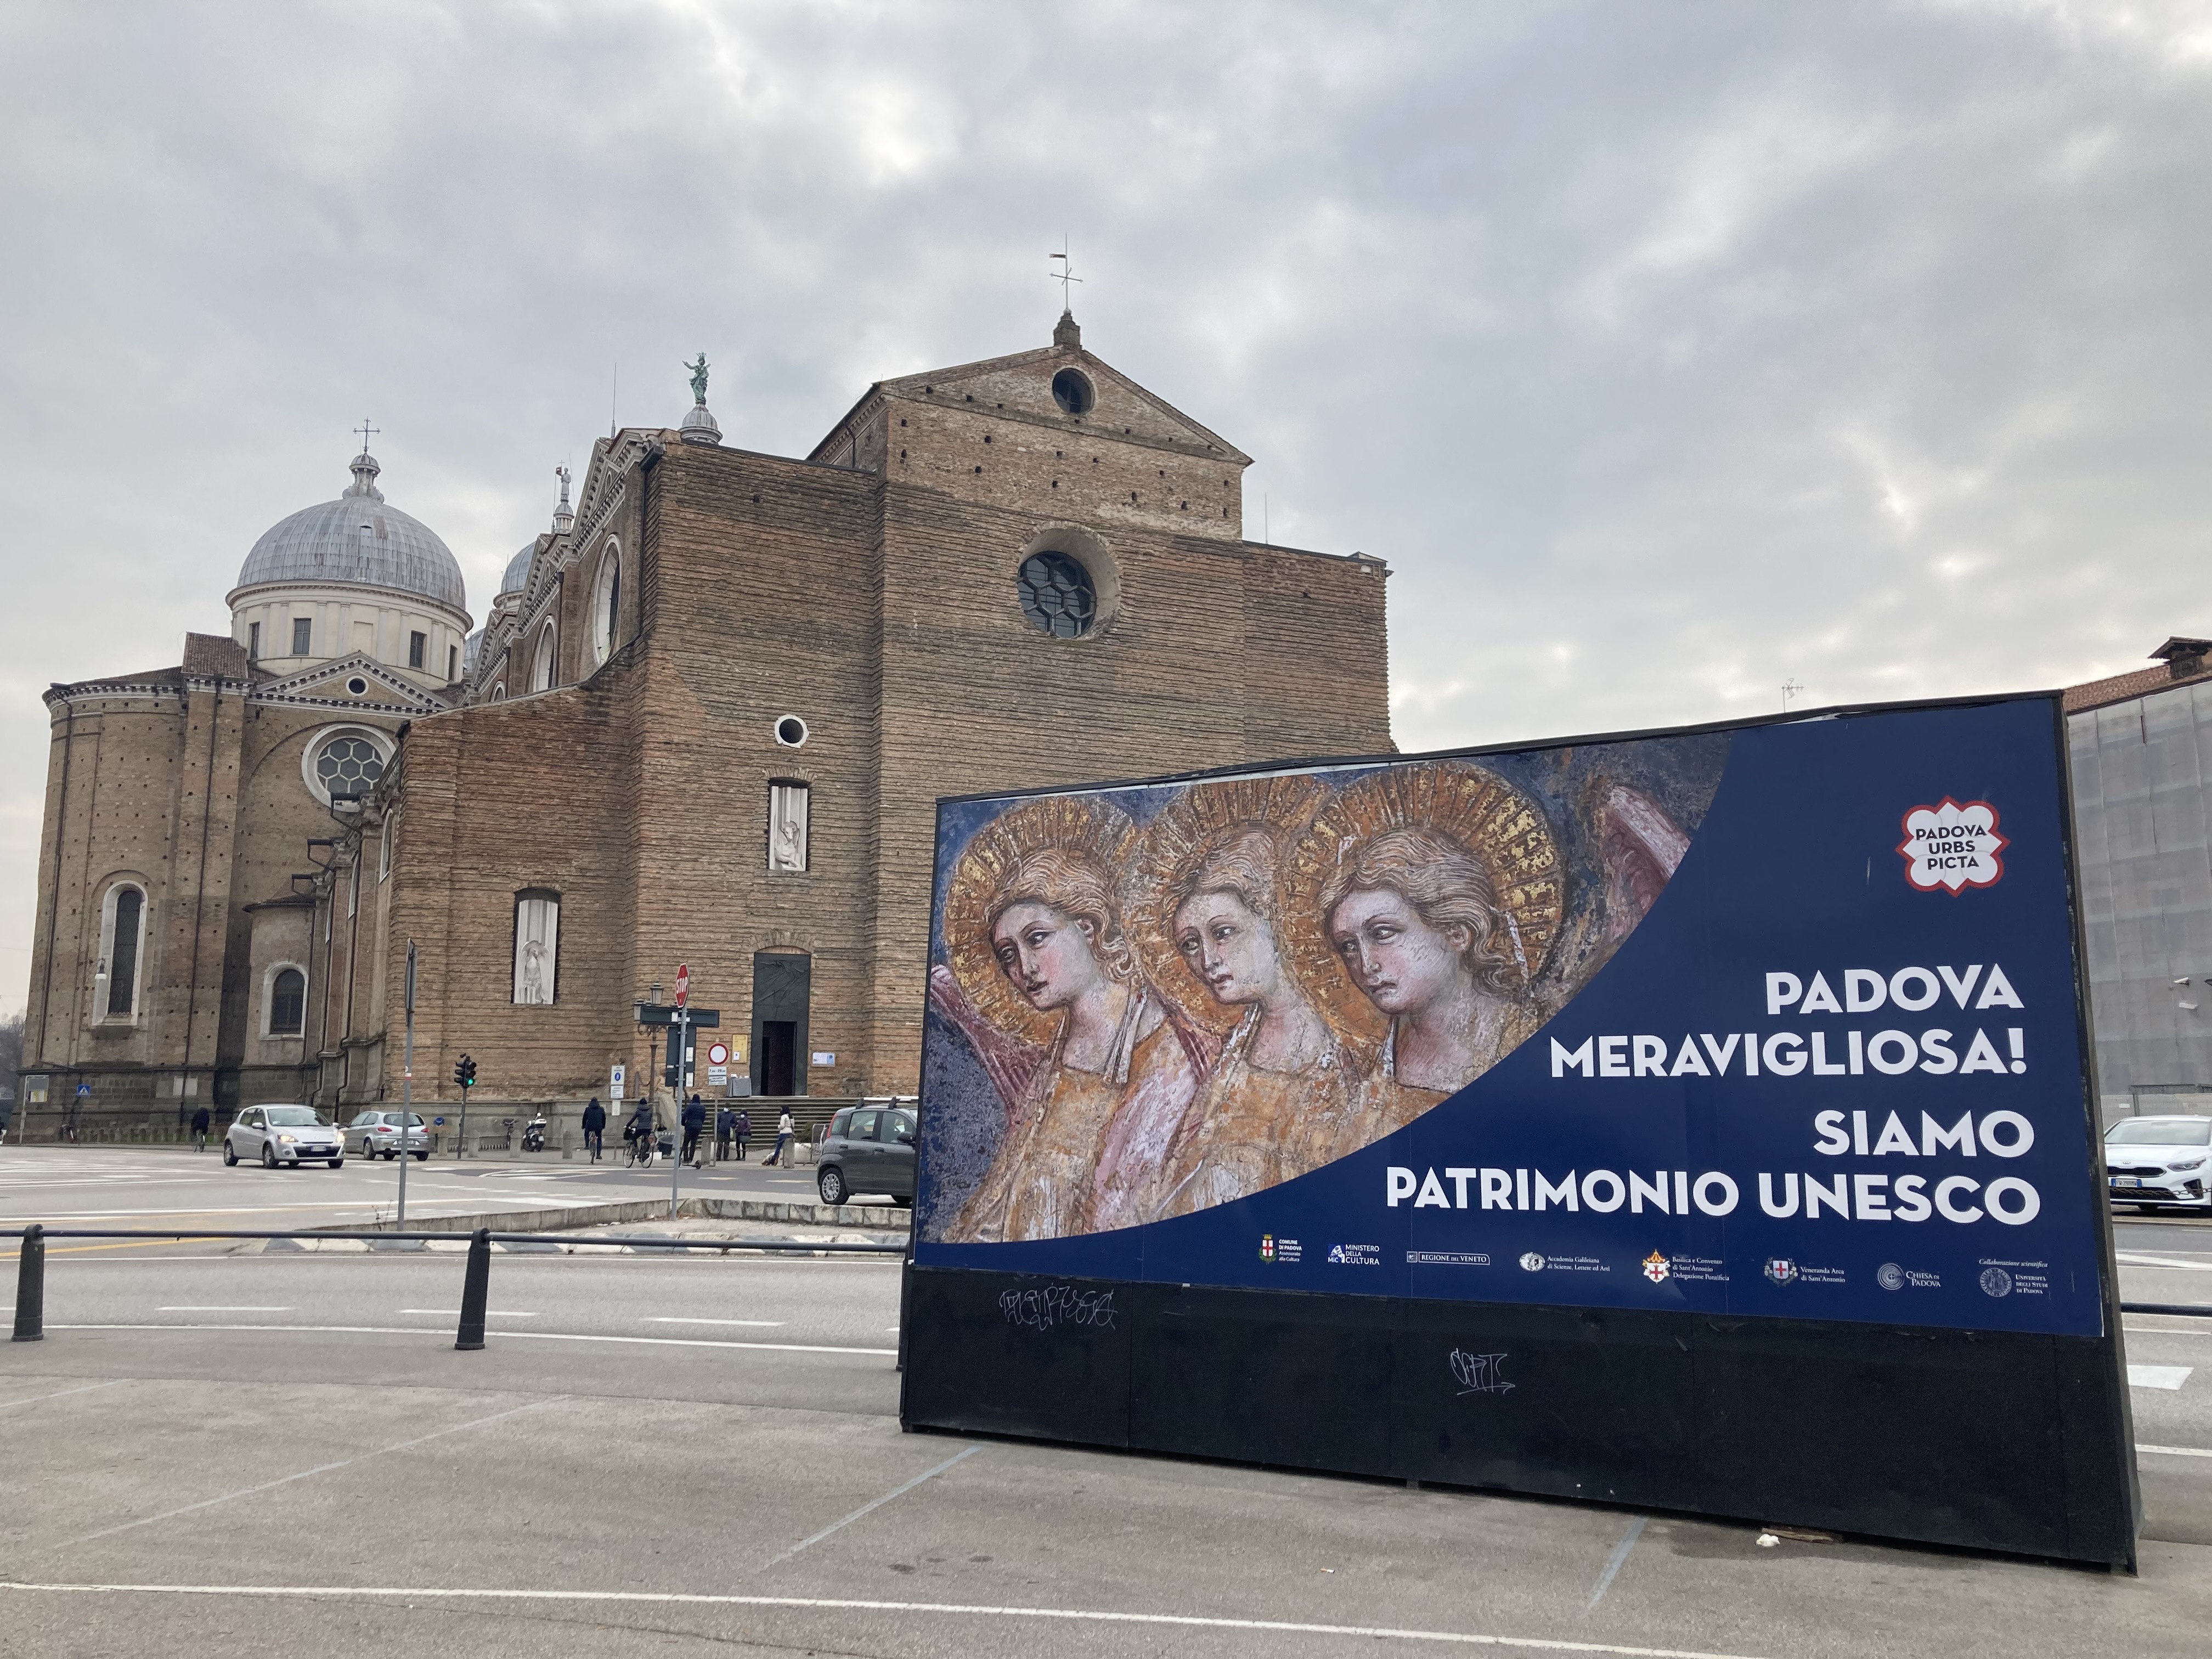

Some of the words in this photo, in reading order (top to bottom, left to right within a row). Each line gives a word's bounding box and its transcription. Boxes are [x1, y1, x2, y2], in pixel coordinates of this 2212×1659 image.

[1916, 825, 1987, 840] PADOVA
[1928, 840, 1976, 855] URBS
[1927, 856, 1979, 870] PICTA
[676, 976, 687, 994] STOP
[1765, 963, 2024, 1015] PADOVA
[1550, 1026, 2027, 1077] MERAVIGLIOSA!
[1813, 1109, 2035, 1158] SIAMO
[1386, 1166, 1739, 1217] PATRIMONIO
[1758, 1172, 2041, 1226] UNESCO
[1345, 1244, 1380, 1252] MINISTERO
[1345, 1257, 1380, 1265] CULTURA
[1673, 1272, 1704, 1280] Delegazione
[1906, 1271, 1933, 1279] CHIESA
[1911, 1279, 1941, 1287] PADOVA
